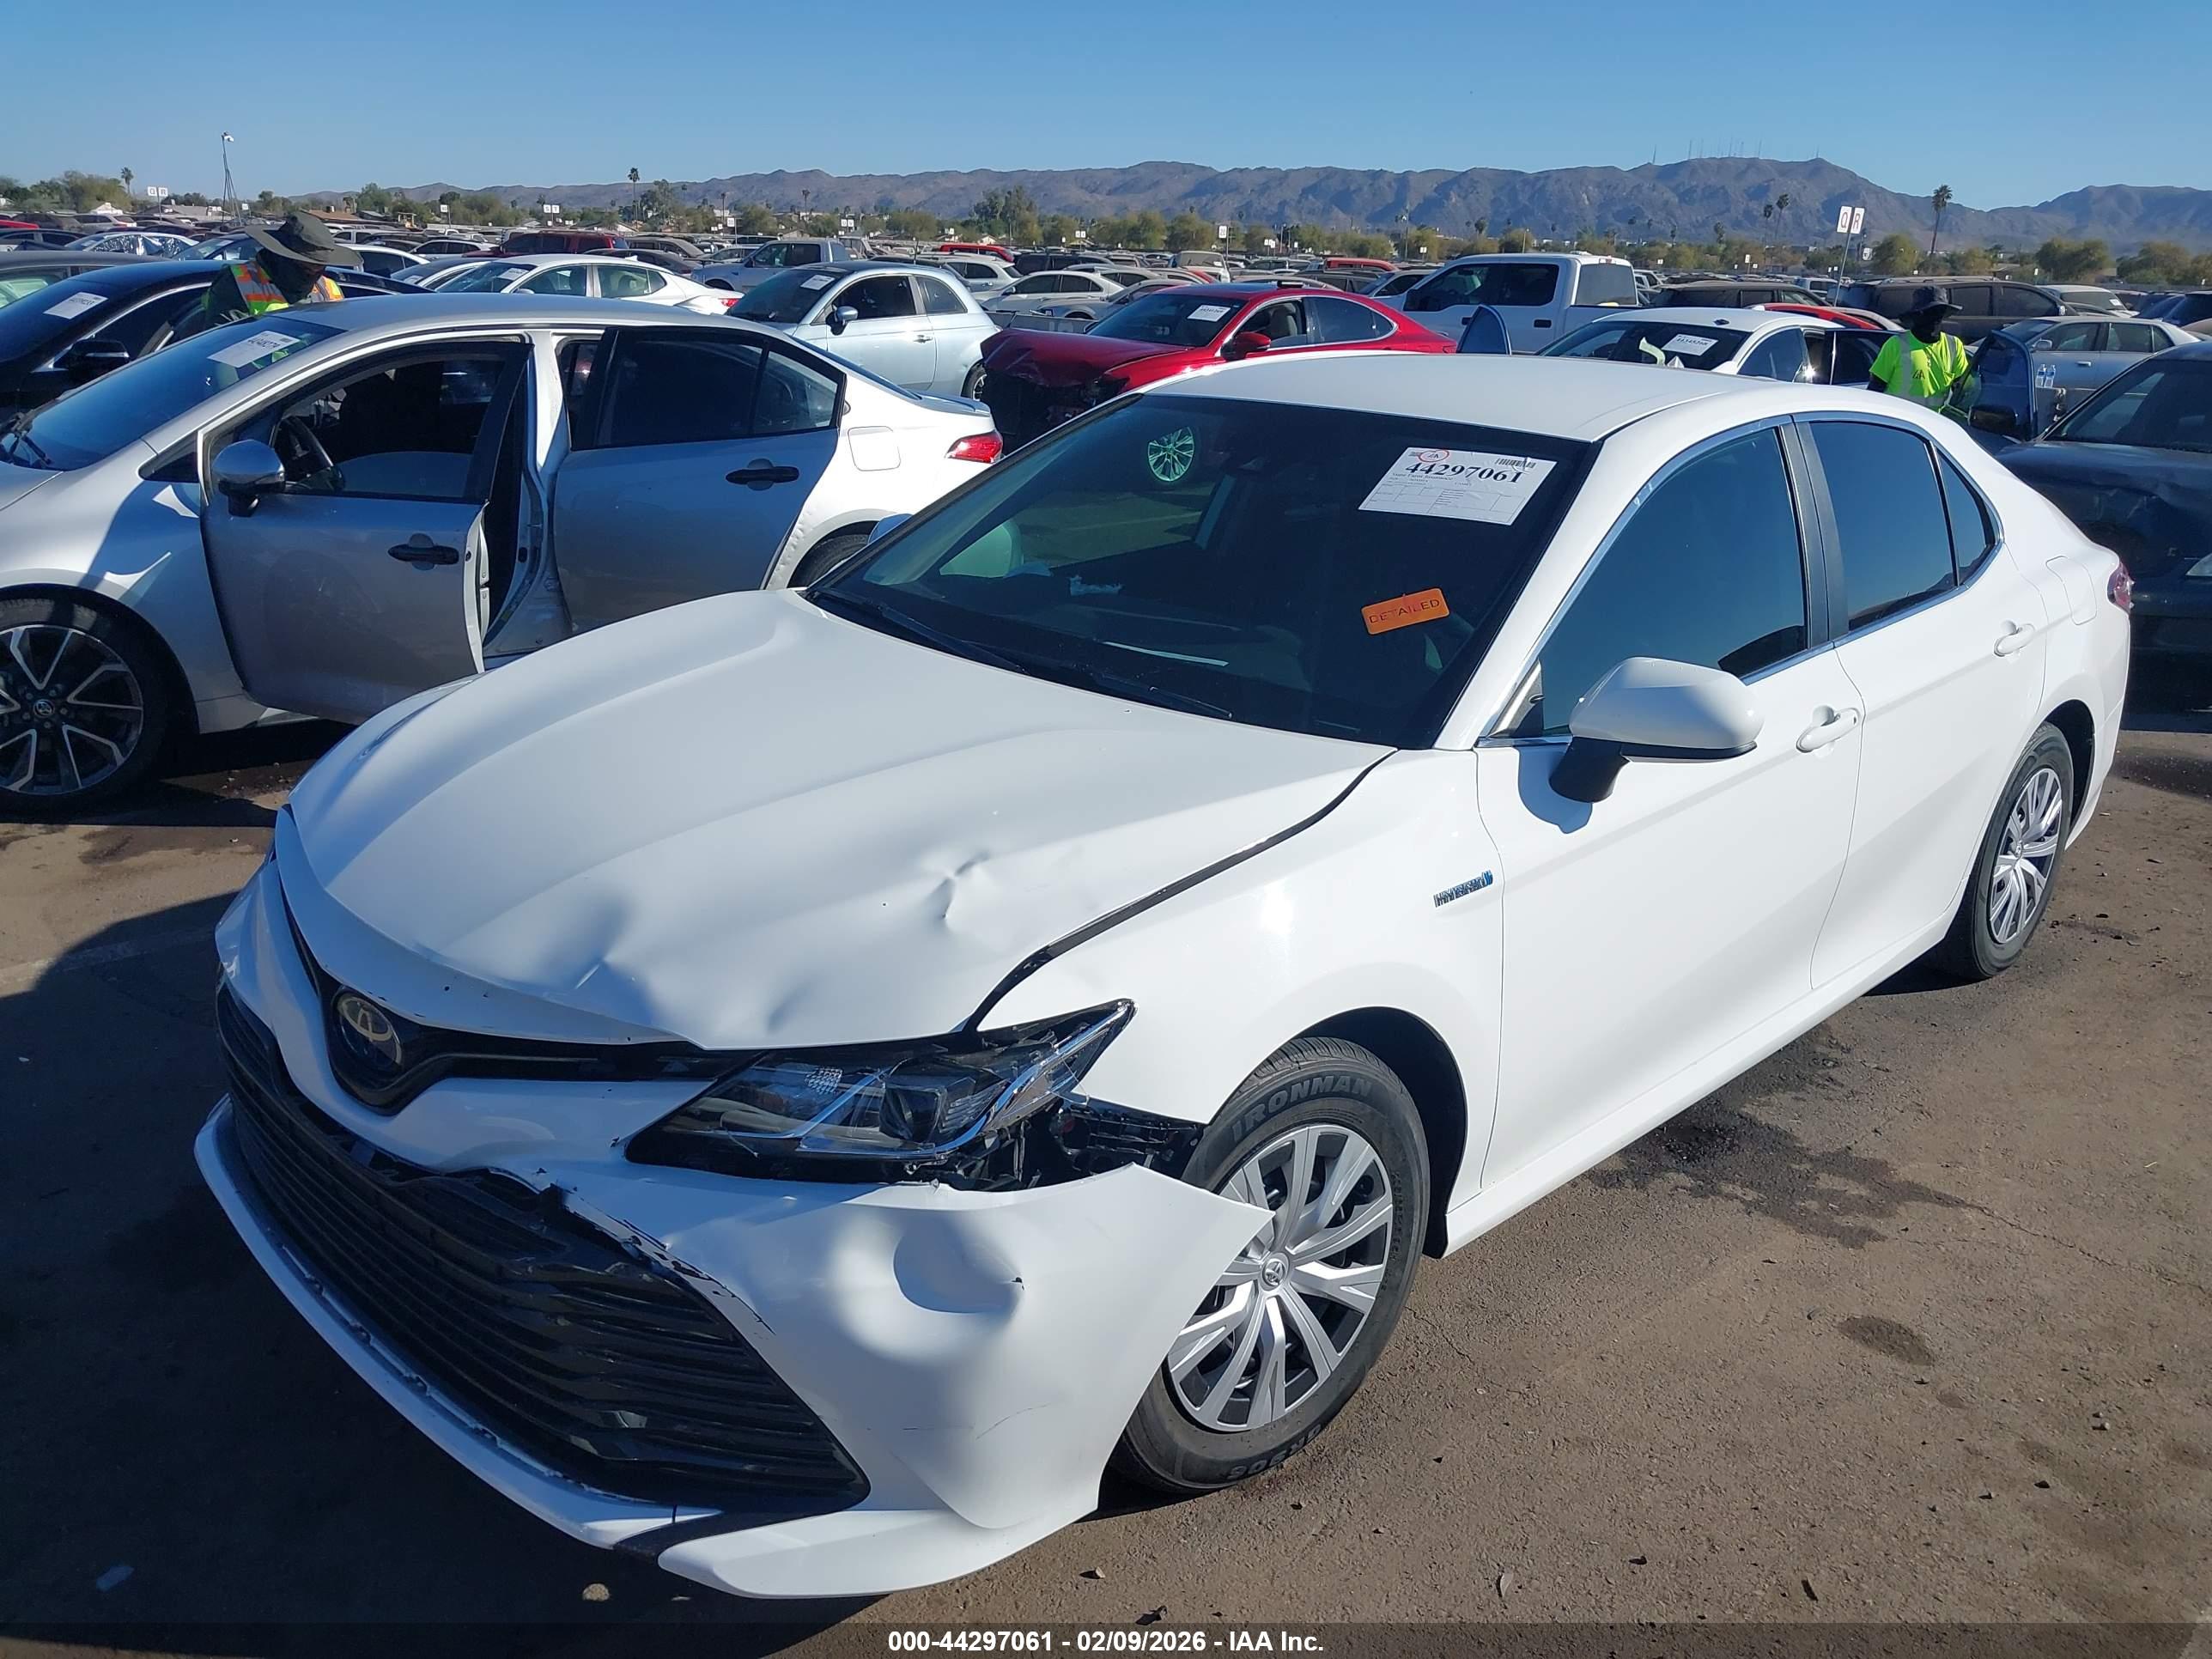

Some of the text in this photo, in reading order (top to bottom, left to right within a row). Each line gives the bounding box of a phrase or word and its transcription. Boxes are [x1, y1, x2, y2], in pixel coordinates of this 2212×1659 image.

[1840, 211, 1861, 229] Q R
[1405, 462, 1525, 483] 44297061
[1369, 599, 1440, 623] DETAILED
[1231, 1075, 1371, 1143] IRONMAN
